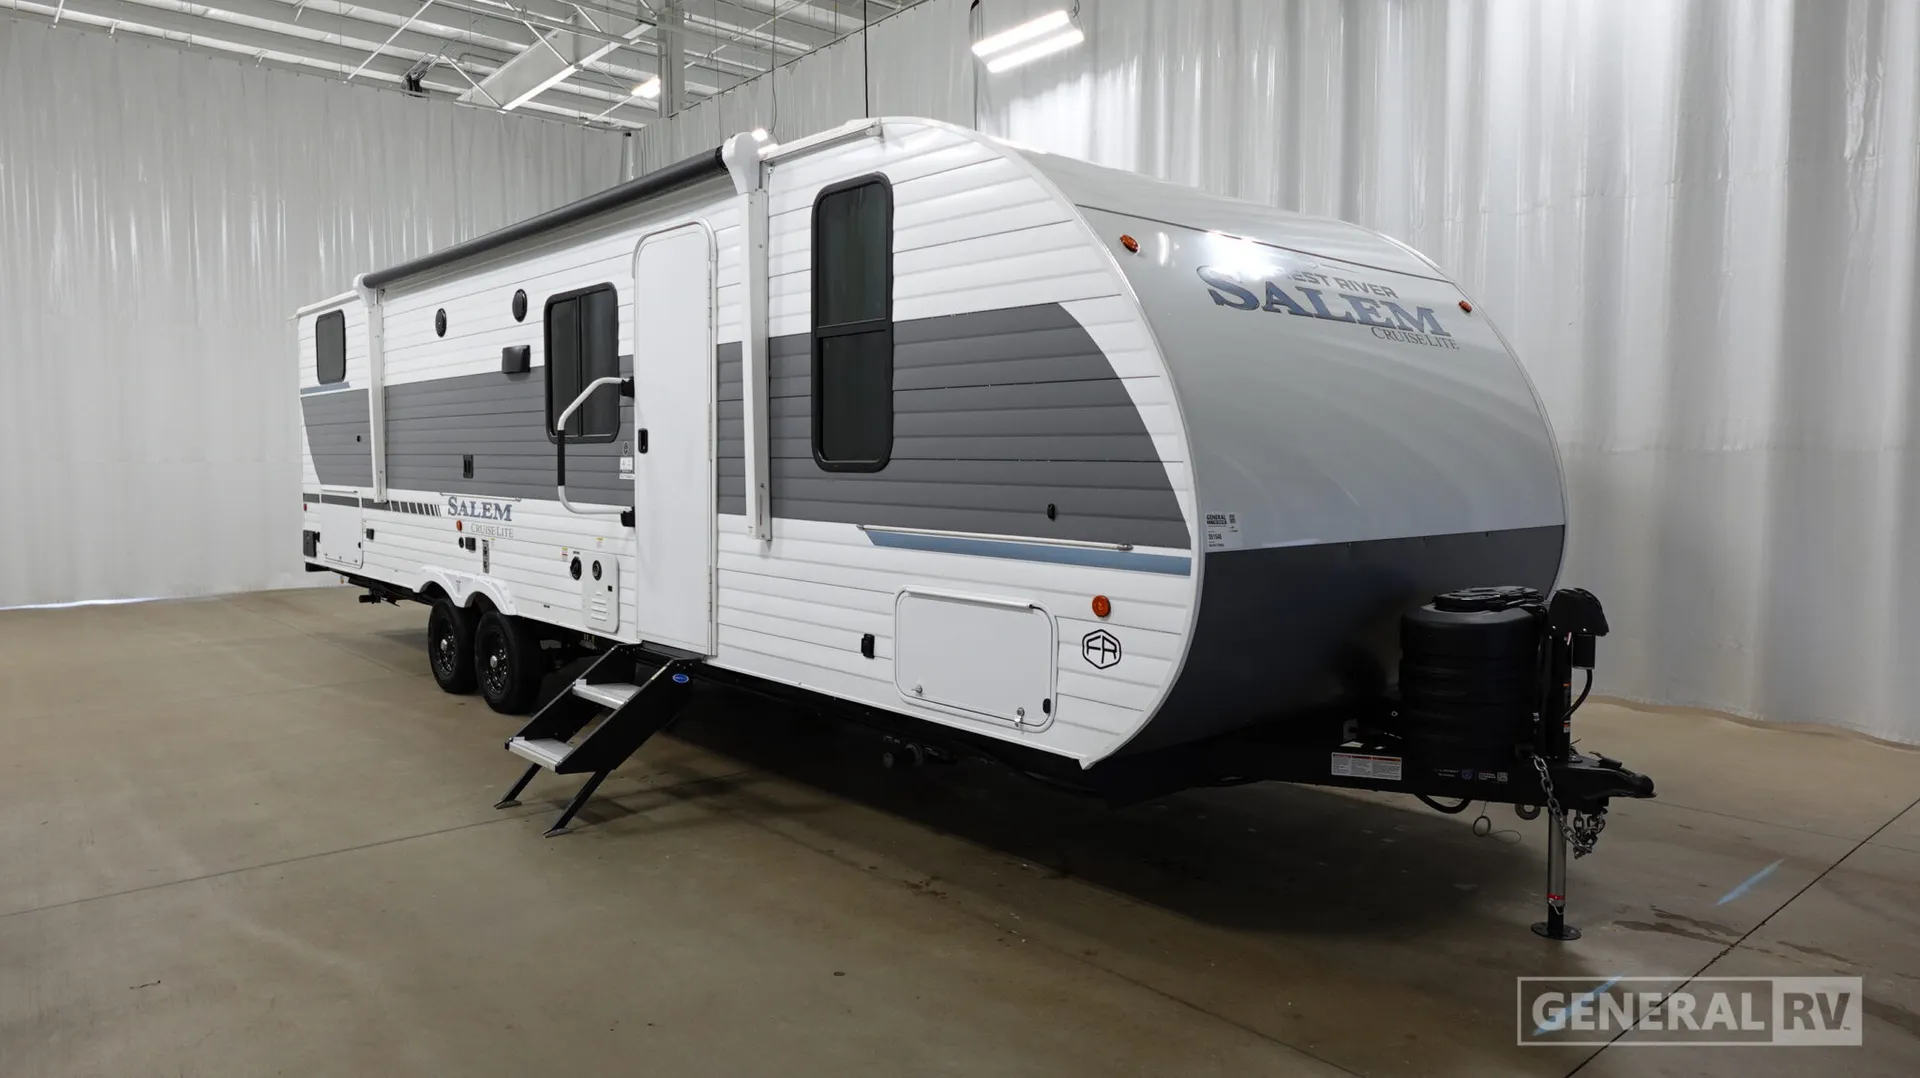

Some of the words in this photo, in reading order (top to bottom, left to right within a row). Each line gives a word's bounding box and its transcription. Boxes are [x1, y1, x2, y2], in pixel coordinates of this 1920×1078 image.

[1196, 264, 1452, 337] SALEM
[1335, 276, 1399, 300] RIVER
[447, 496, 513, 521] SALEM
